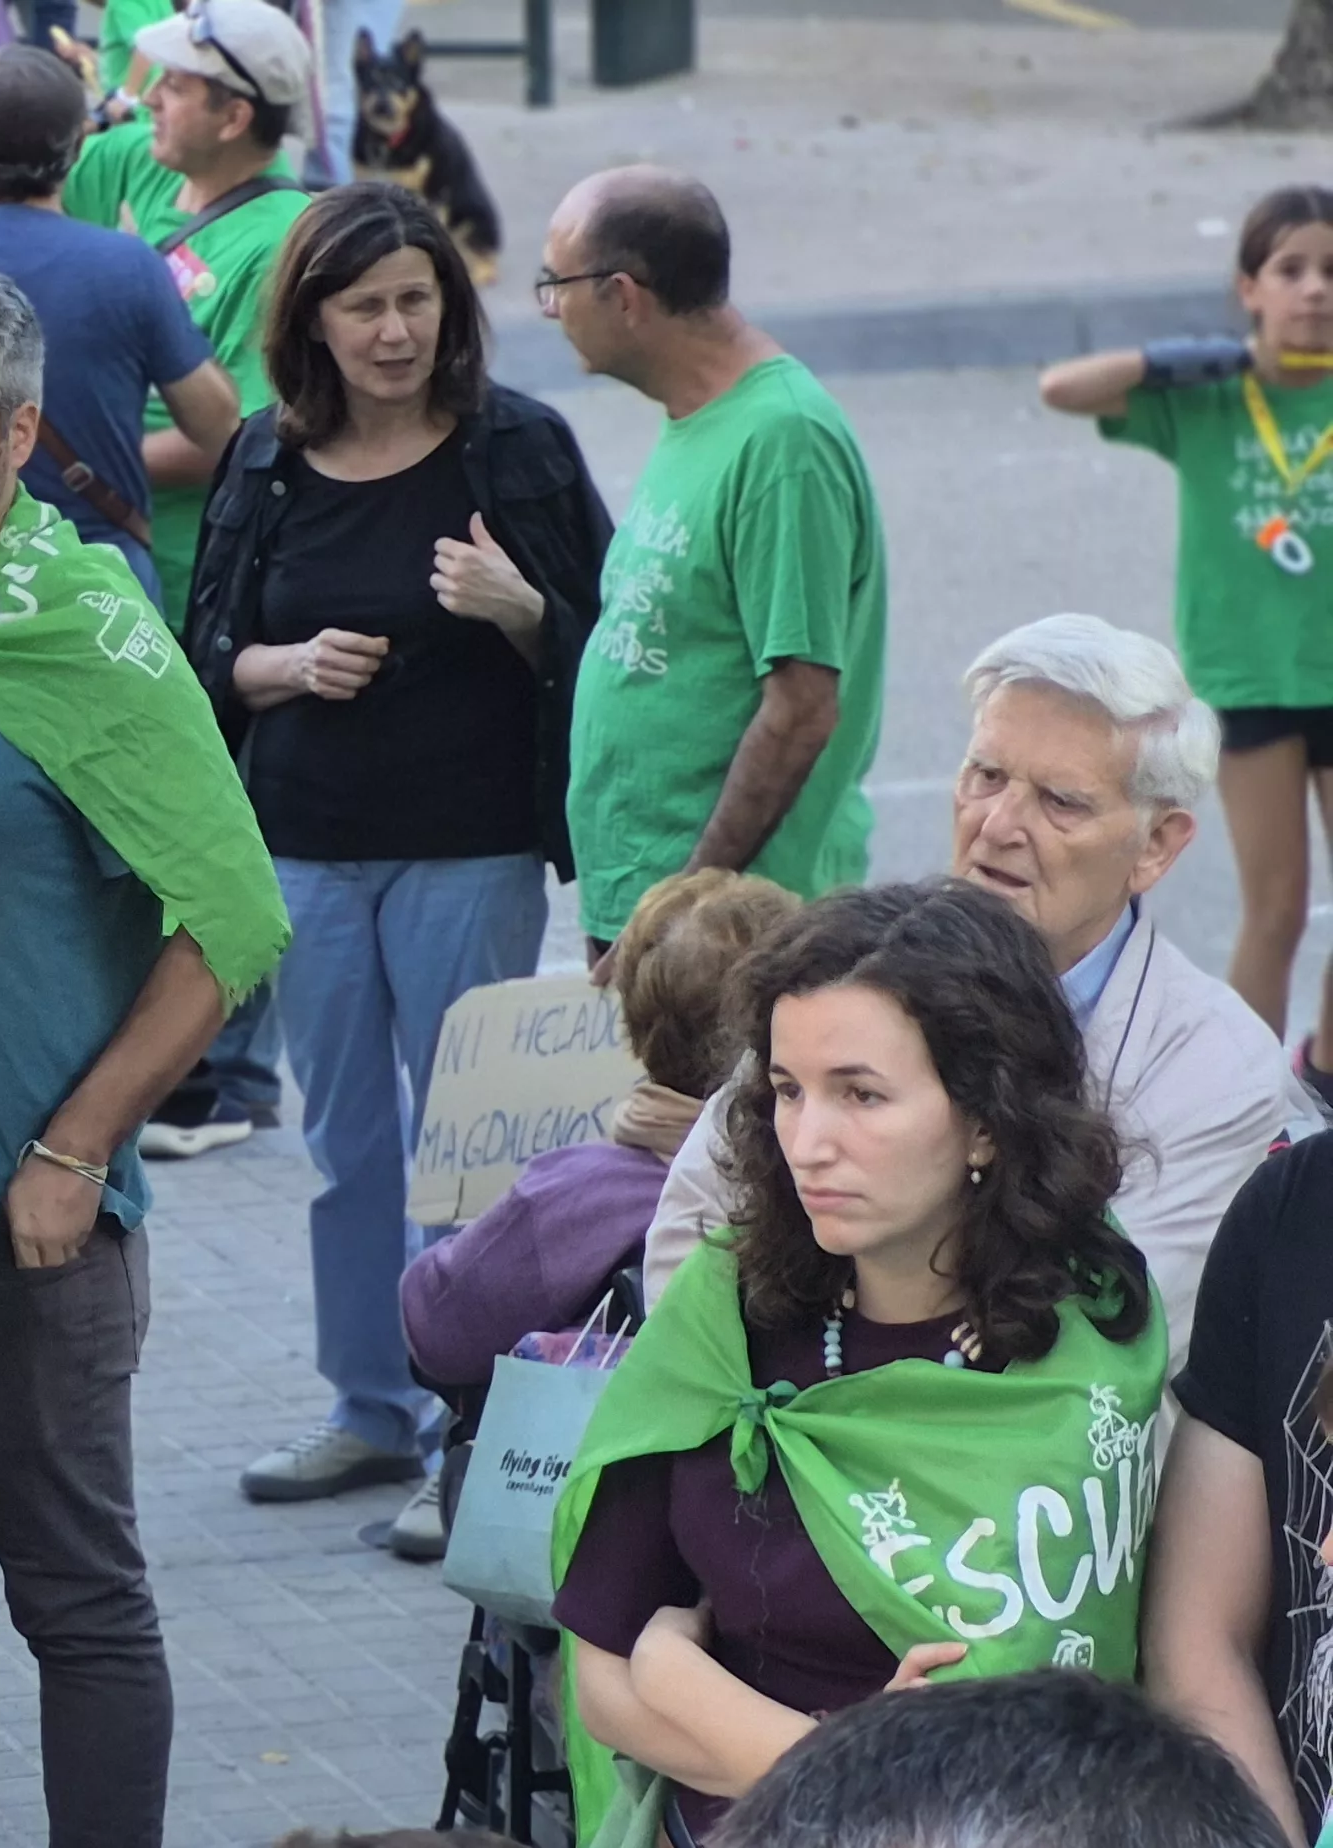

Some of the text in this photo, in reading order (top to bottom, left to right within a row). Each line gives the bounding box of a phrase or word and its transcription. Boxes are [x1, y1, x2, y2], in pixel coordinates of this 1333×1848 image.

[440, 1011, 485, 1075] NI
[500, 1448, 541, 1479] flying
[870, 1440, 1145, 1638] ESCU
